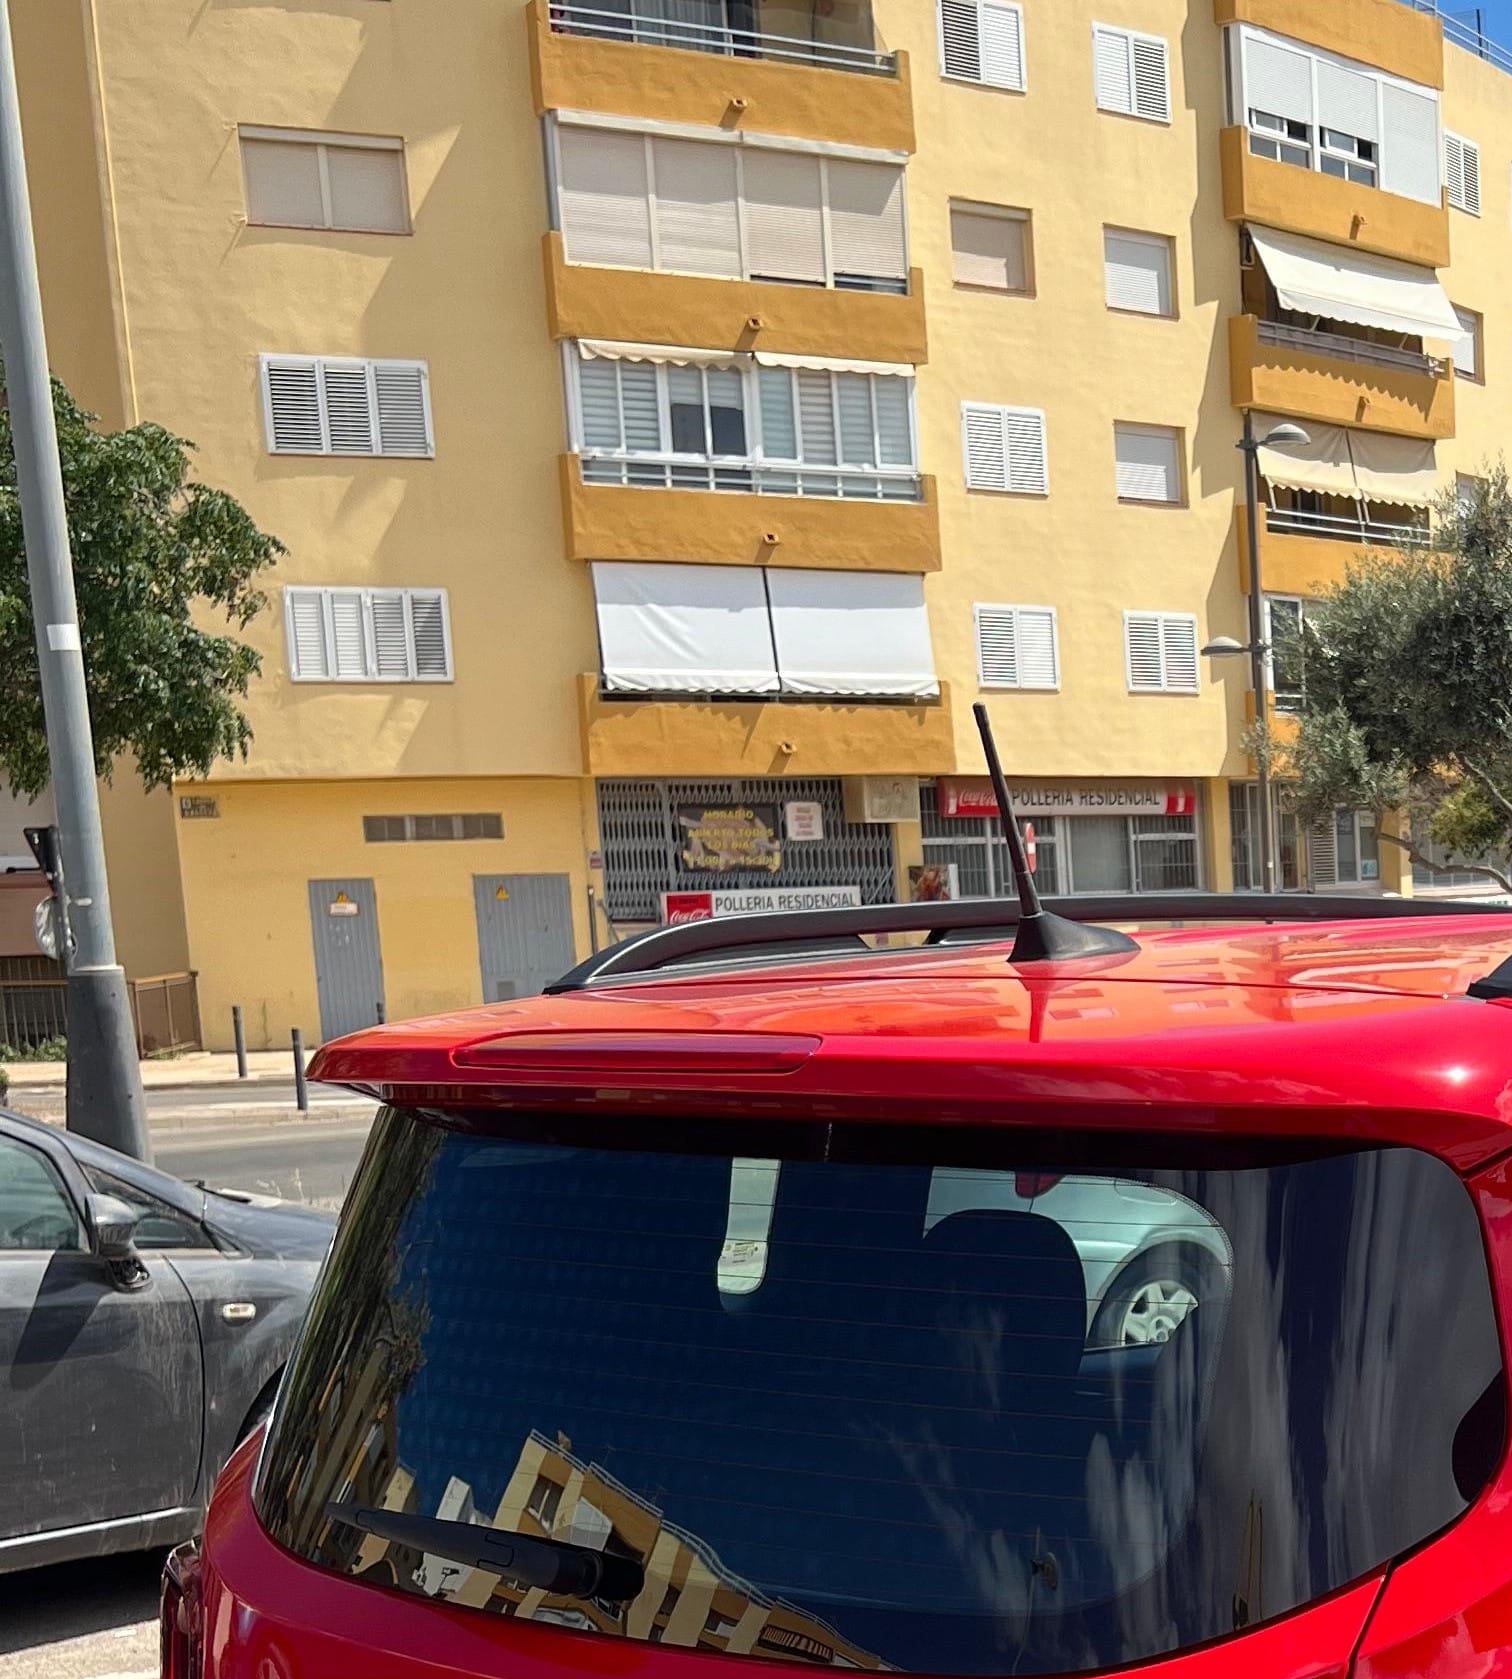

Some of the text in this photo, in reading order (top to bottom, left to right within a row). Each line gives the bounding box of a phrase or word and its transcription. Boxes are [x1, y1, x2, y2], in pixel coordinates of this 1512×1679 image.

[1012, 789, 1161, 806] POLLERIA RESIDENCIAL
[714, 894, 774, 912] POLLERIA
[778, 892, 857, 911] RESIDENCIAL
